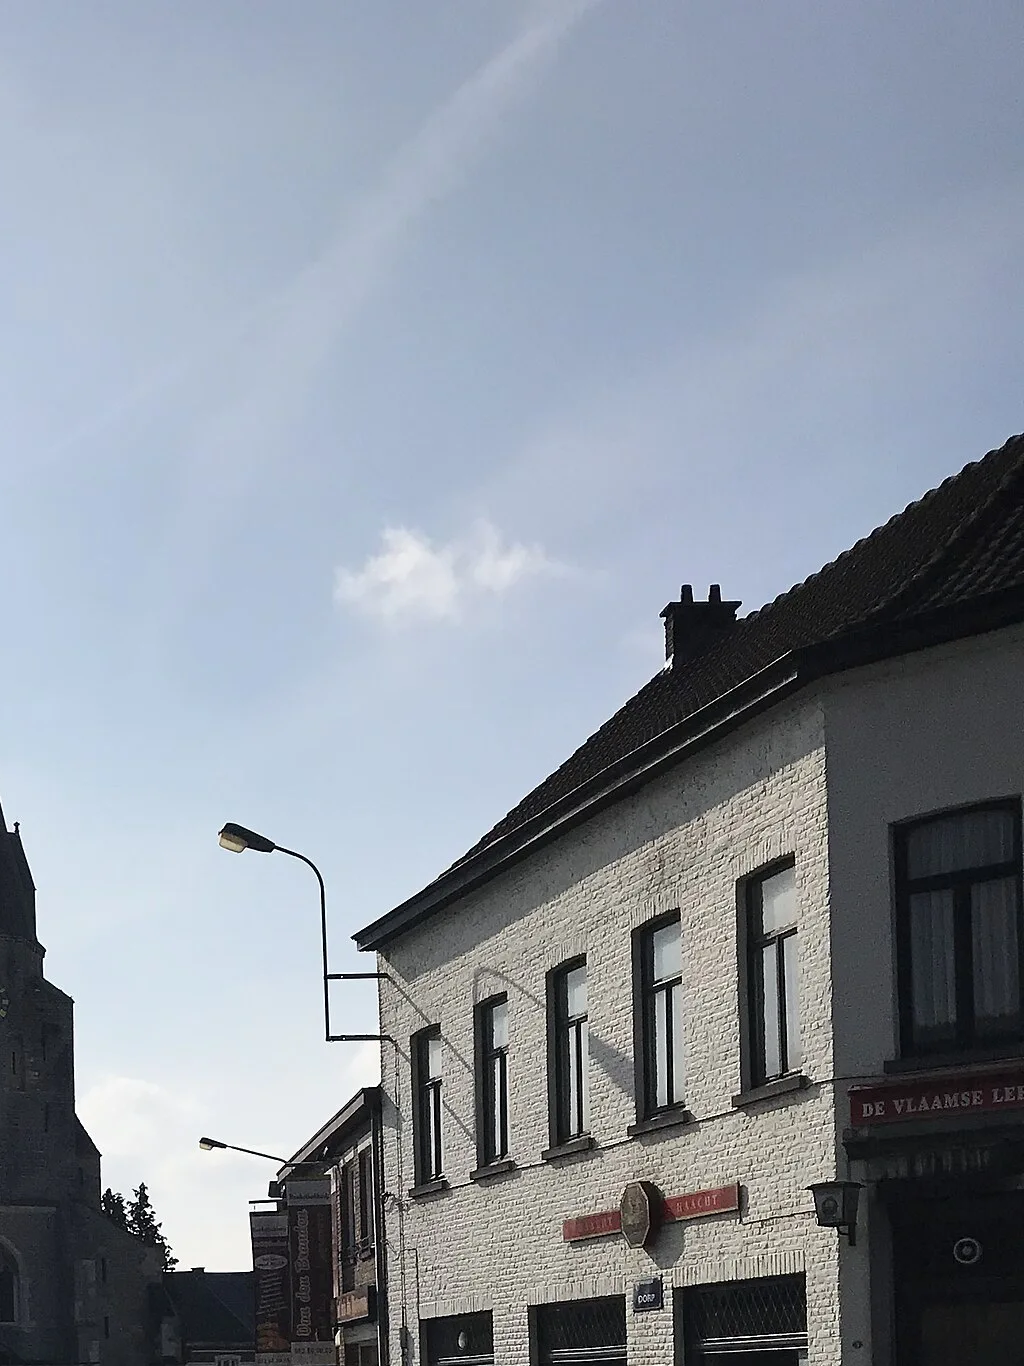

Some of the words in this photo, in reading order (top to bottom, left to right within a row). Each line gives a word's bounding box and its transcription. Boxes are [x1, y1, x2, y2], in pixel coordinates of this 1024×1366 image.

[862, 1101, 885, 1118] DE
[893, 1090, 984, 1114] VLAAMSE
[637, 1293, 656, 1304] DORP
